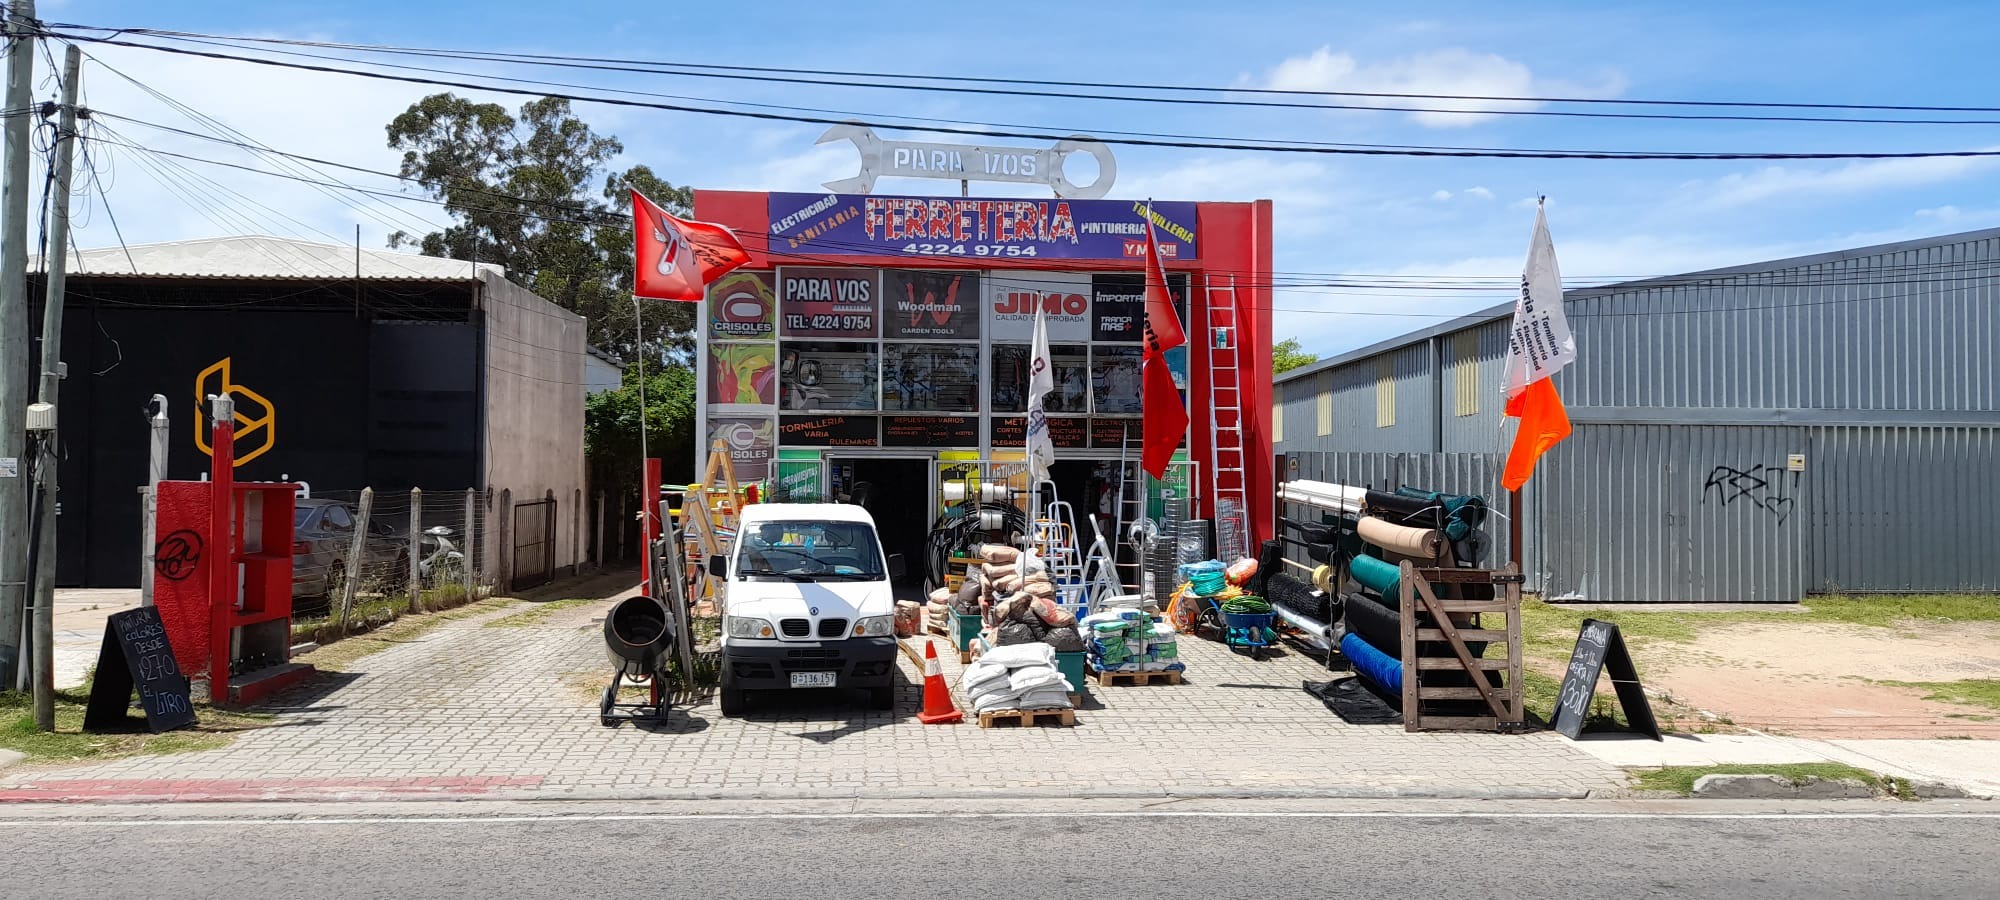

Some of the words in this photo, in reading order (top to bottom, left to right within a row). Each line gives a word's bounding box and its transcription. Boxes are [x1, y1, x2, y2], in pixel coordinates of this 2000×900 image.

[894, 148, 964, 173] PARA
[983, 152, 1037, 176] VOS
[770, 194, 838, 235] ELECTRICIDAD
[865, 197, 1079, 245] FERRETERIA
[787, 205, 860, 249] SANITARIA
[1081, 222, 1146, 235] PINTURERIA
[903, 243, 966, 256] 4224
[975, 244, 1037, 257] 9754
[1136, 243, 1177, 257] MS!!!
[786, 279, 832, 301] PARA
[836, 280, 870, 301] VOS
[898, 301, 961, 312] Woodman
[994, 292, 1087, 315] JIMO
[786, 315, 808, 329] TEL:
[811, 315, 839, 329] 4224
[843, 315, 871, 329] 9754
[995, 314, 1028, 322] CALIDAD
[714, 322, 772, 331] CRISOLES
[779, 417, 845, 432] TORNILLERIA
[894, 416, 936, 424] REPUESTOS
[829, 438, 877, 446] RULEMANES
[731, 450, 768, 459] ISOLES
[125, 622, 163, 641] COLORES
[134, 637, 165, 654] DESDE
[143, 684, 154, 698] EL
[155, 691, 187, 715] LITRO
